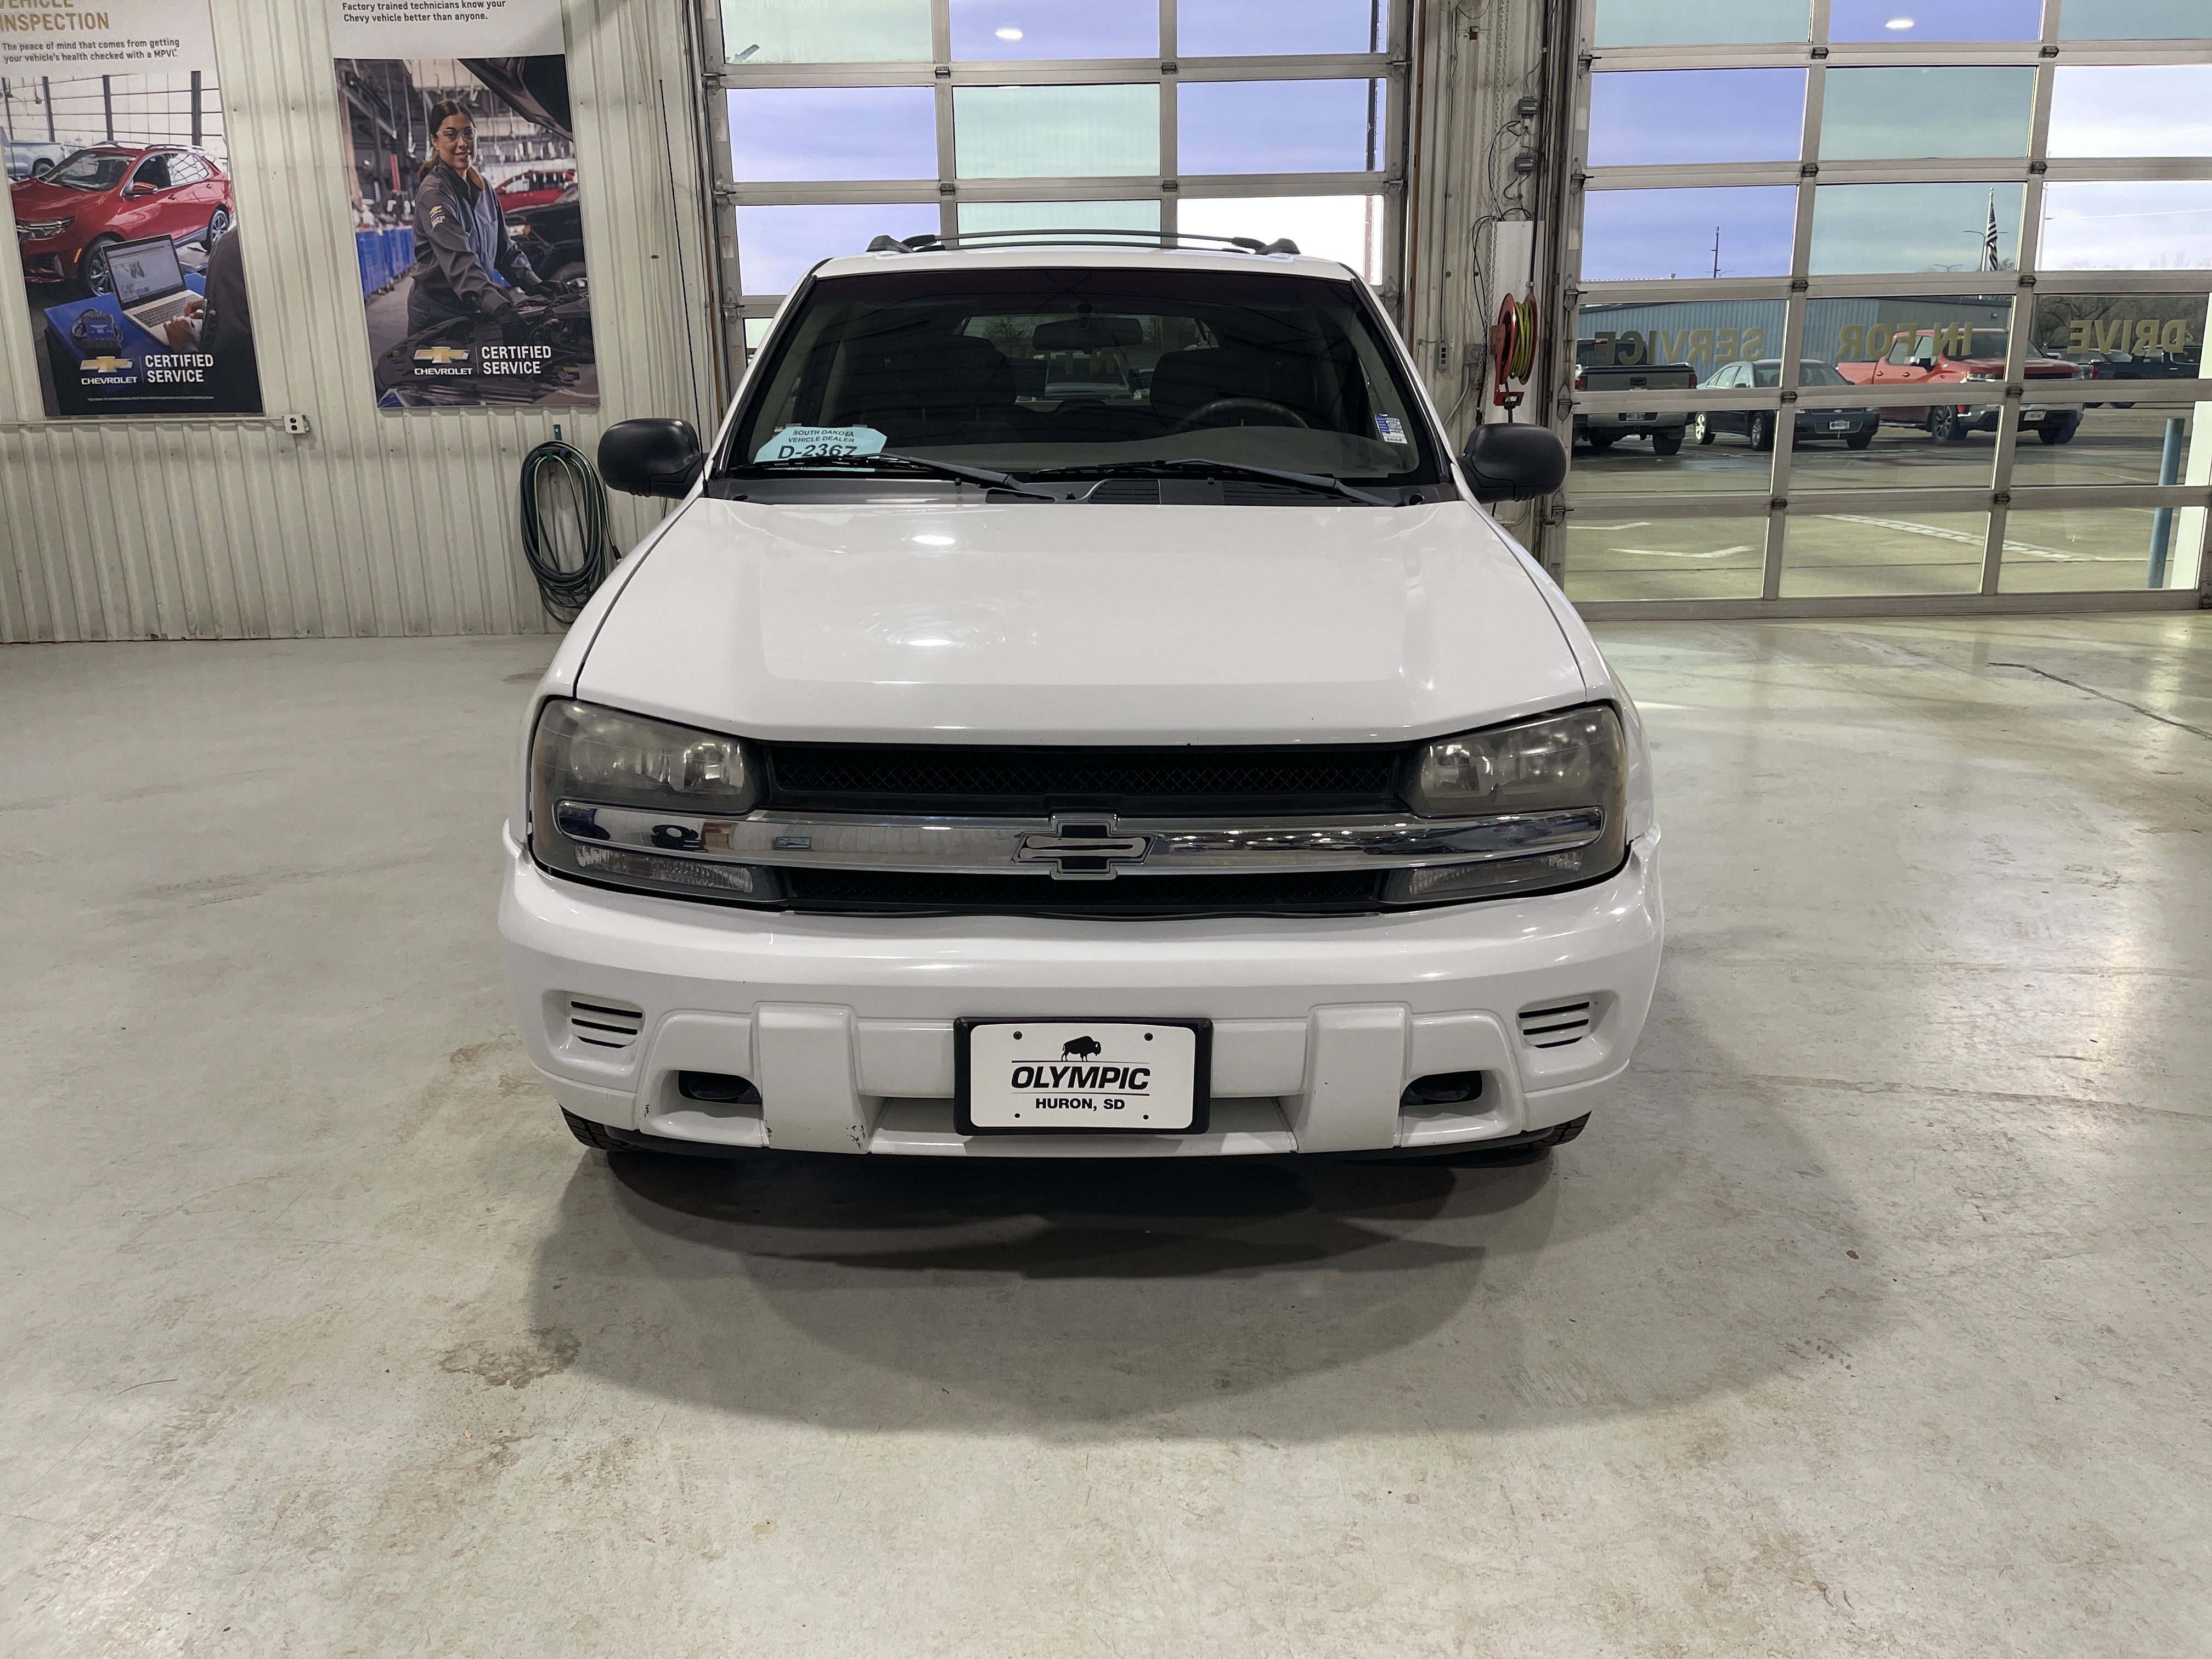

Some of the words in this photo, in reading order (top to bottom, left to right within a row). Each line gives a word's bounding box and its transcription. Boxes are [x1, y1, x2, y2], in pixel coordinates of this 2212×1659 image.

[342, 3, 375, 12] Factory
[377, 2, 408, 10] trained
[410, 1, 460, 10] technicians
[461, 0, 484, 8] know
[486, 1, 506, 9] your
[0, 12, 110, 32] INSPECTION
[343, 14, 370, 24] Chevy
[372, 13, 402, 22] vehicle
[404, 13, 431, 21] better
[433, 13, 452, 21] than
[455, 13, 488, 22] anyone.
[2, 43, 17, 51] The
[20, 43, 44, 52] peace
[46, 42, 54, 50] of
[57, 41, 77, 49] mind
[127, 40, 147, 48] from
[150, 38, 180, 48] getting
[4, 55, 22, 64] your
[25, 53, 60, 62] vehicle's
[62, 52, 88, 61] health
[91, 52, 124, 60] checked
[126, 50, 145, 59] with
[481, 346, 552, 359] CERTIFIED
[145, 354, 214, 368] CERTIFIED
[483, 361, 541, 375] SERVICE
[81, 376, 138, 385] CHEVROLET
[147, 369, 204, 383] SERVICE
[777, 443, 857, 459] D-2367
[1011, 1066, 1151, 1091] OLYMPIC
[1035, 1098, 1097, 1111] HURON,
[1103, 1098, 1125, 1110] SD
